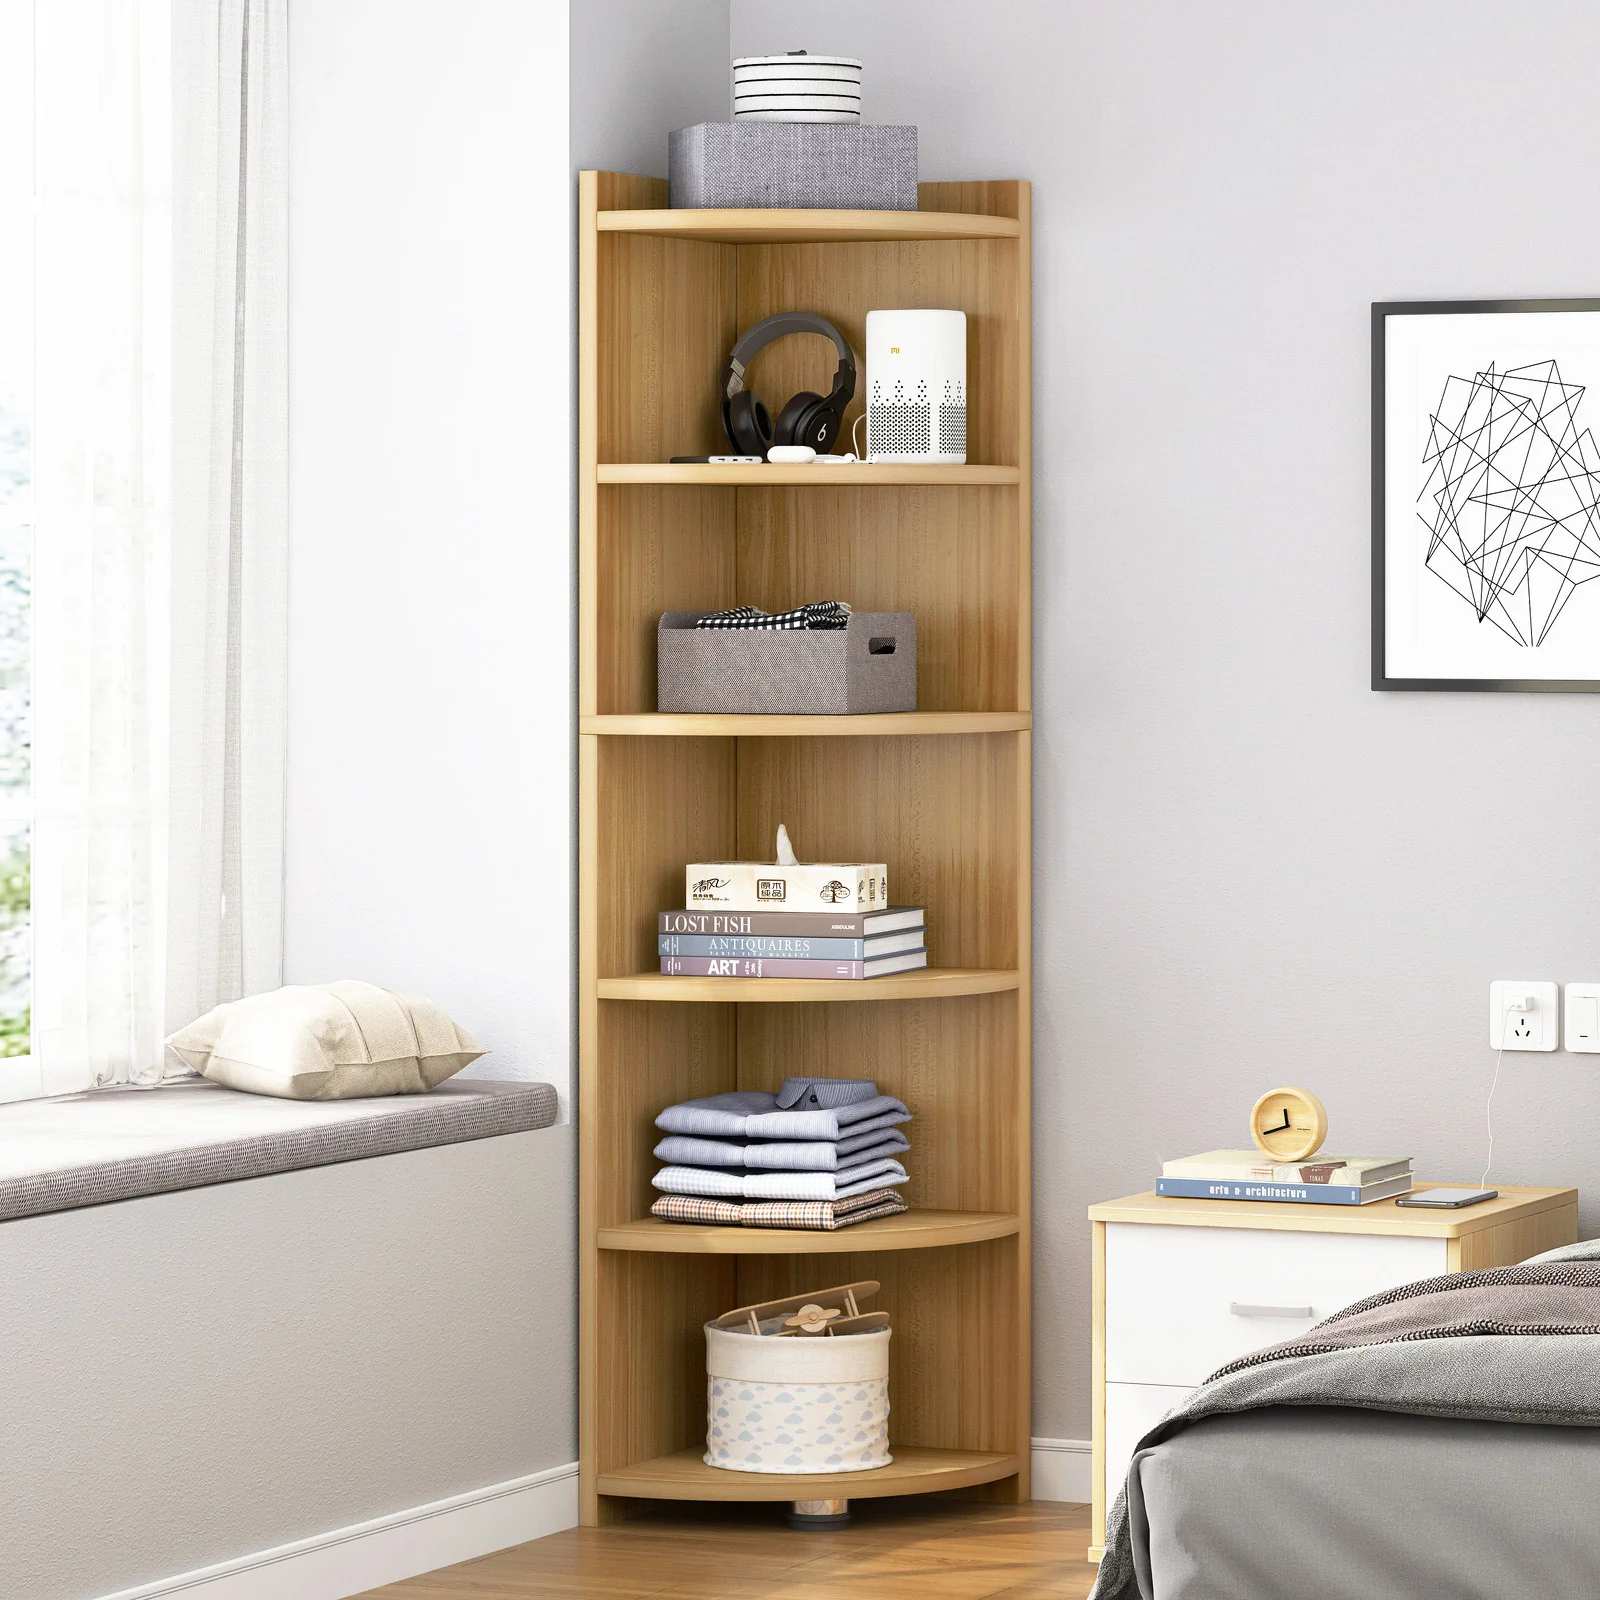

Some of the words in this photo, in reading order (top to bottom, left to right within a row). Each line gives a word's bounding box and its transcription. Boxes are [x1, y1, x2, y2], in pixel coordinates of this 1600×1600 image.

[664, 914, 709, 933] LOST
[712, 915, 753, 934] FISH
[709, 938, 811, 953] ANTIQUAIRES
[707, 959, 740, 976] ART
[1245, 1186, 1307, 1199] architecture
